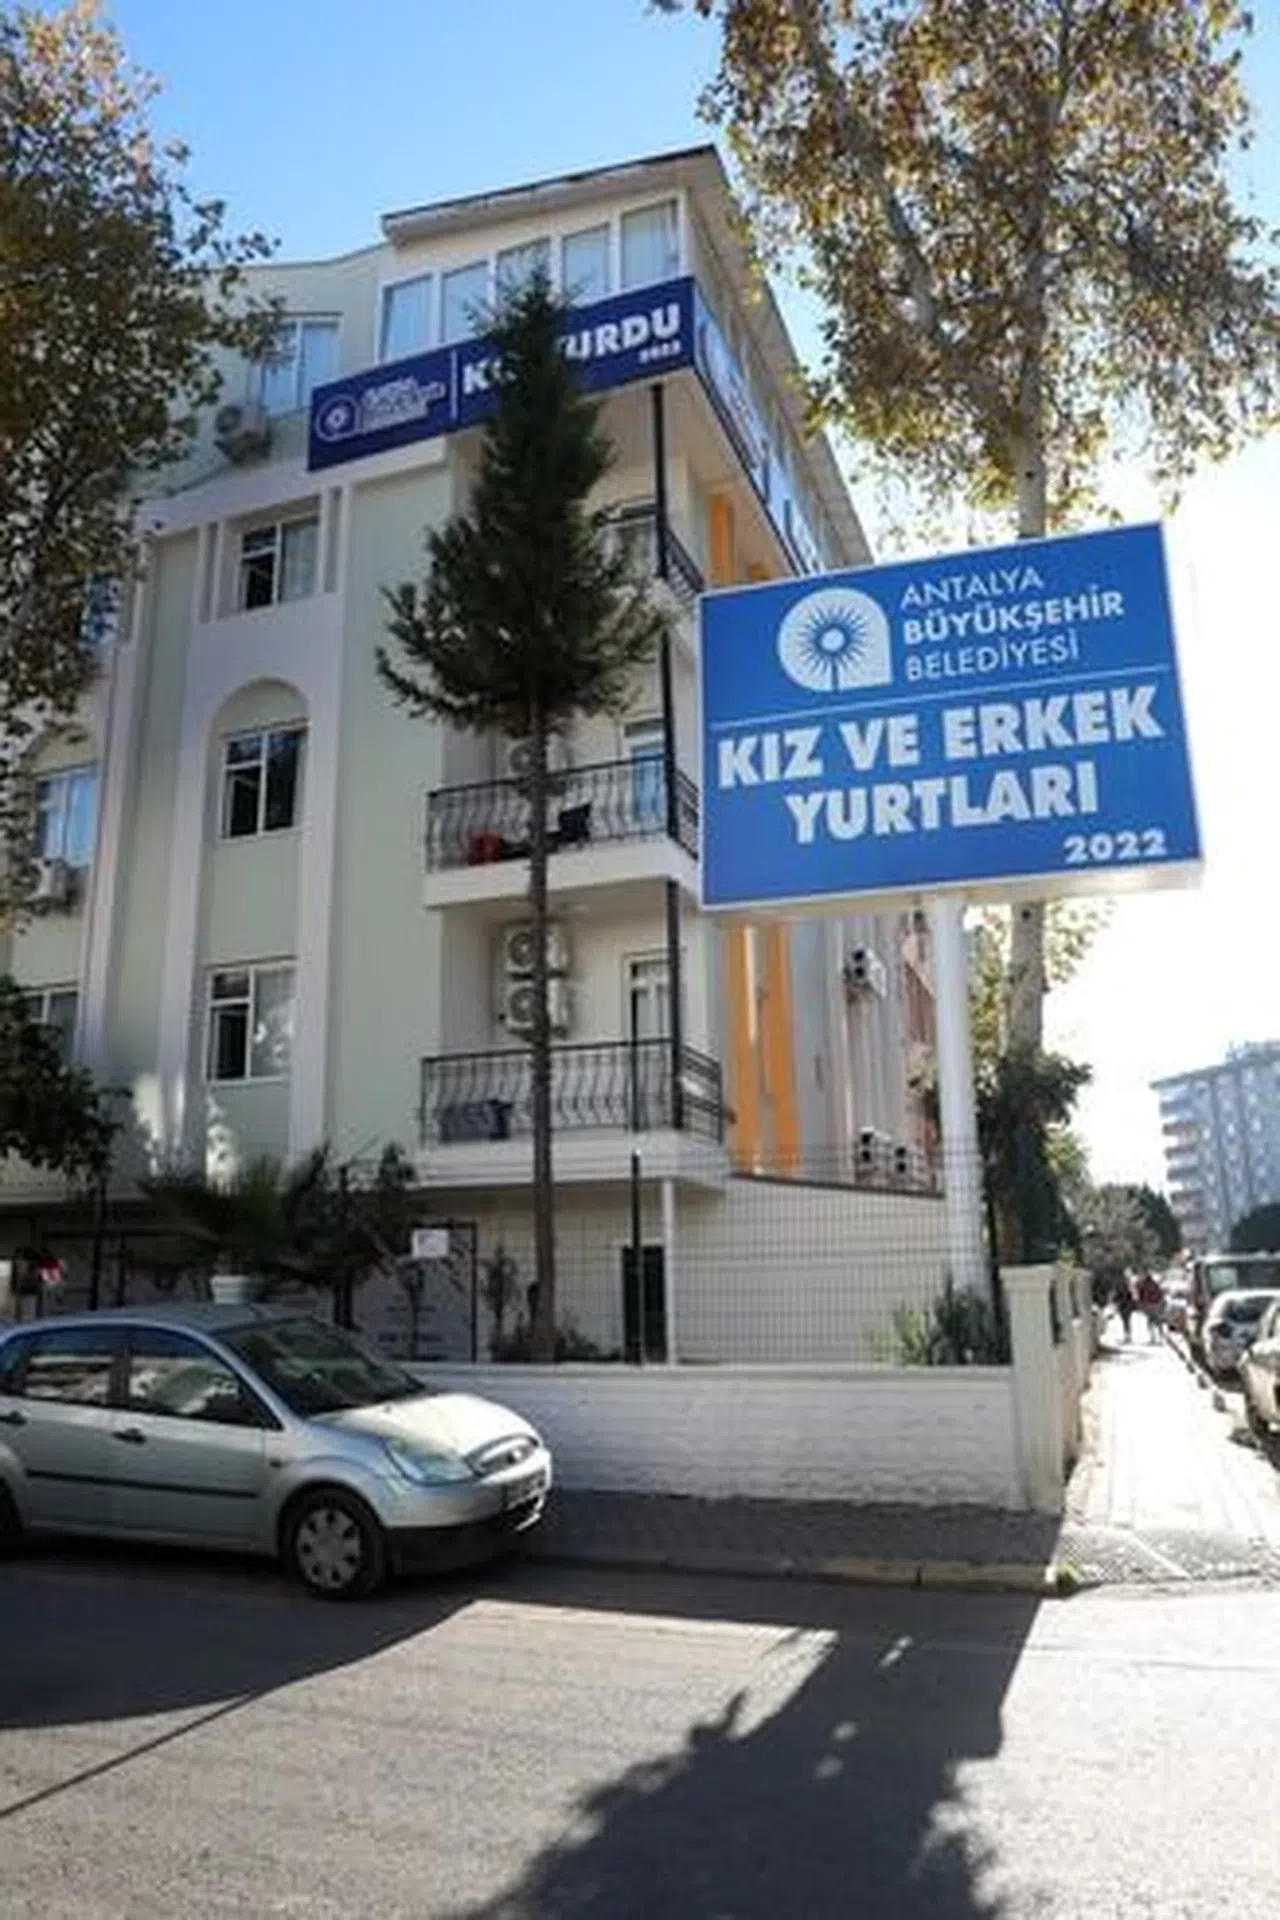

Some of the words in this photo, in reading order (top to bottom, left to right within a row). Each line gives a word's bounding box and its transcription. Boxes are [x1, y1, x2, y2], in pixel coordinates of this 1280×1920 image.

[556, 303, 681, 361] URDU
[901, 566, 1044, 606] ANTALYA
[903, 588, 1125, 645] BÜYÜKŞEHİR
[906, 633, 1079, 681] BELEDİYESİ
[718, 727, 824, 789] KIZ
[839, 713, 920, 771] VE
[942, 685, 1164, 760] ERKEK
[785, 761, 1099, 845] YURTLARI
[1063, 829, 1168, 864] 2022
